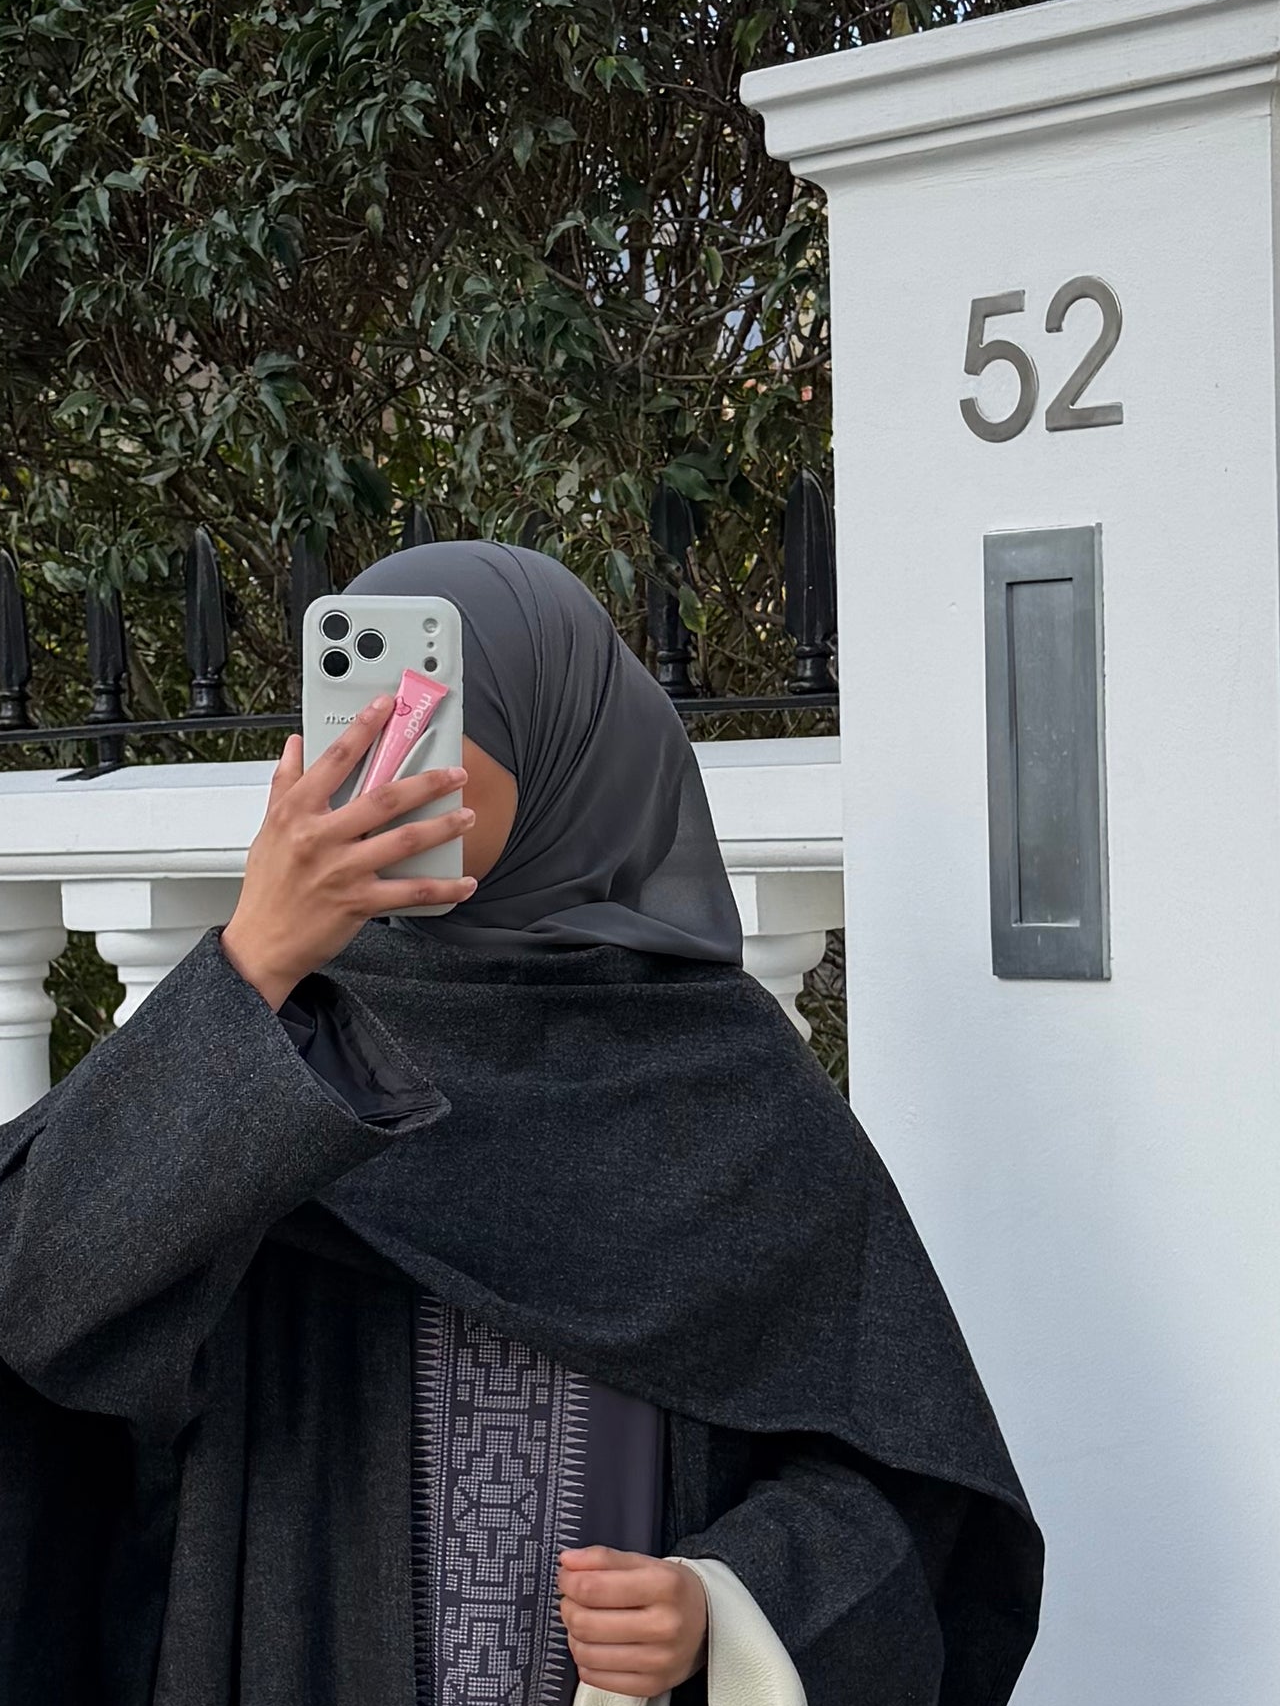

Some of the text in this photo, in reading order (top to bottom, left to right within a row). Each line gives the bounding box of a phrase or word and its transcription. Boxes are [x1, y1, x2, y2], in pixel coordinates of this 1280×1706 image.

[959, 274, 1124, 444] 52
[324, 711, 358, 725] rhod
[404, 692, 432, 740] rhode
